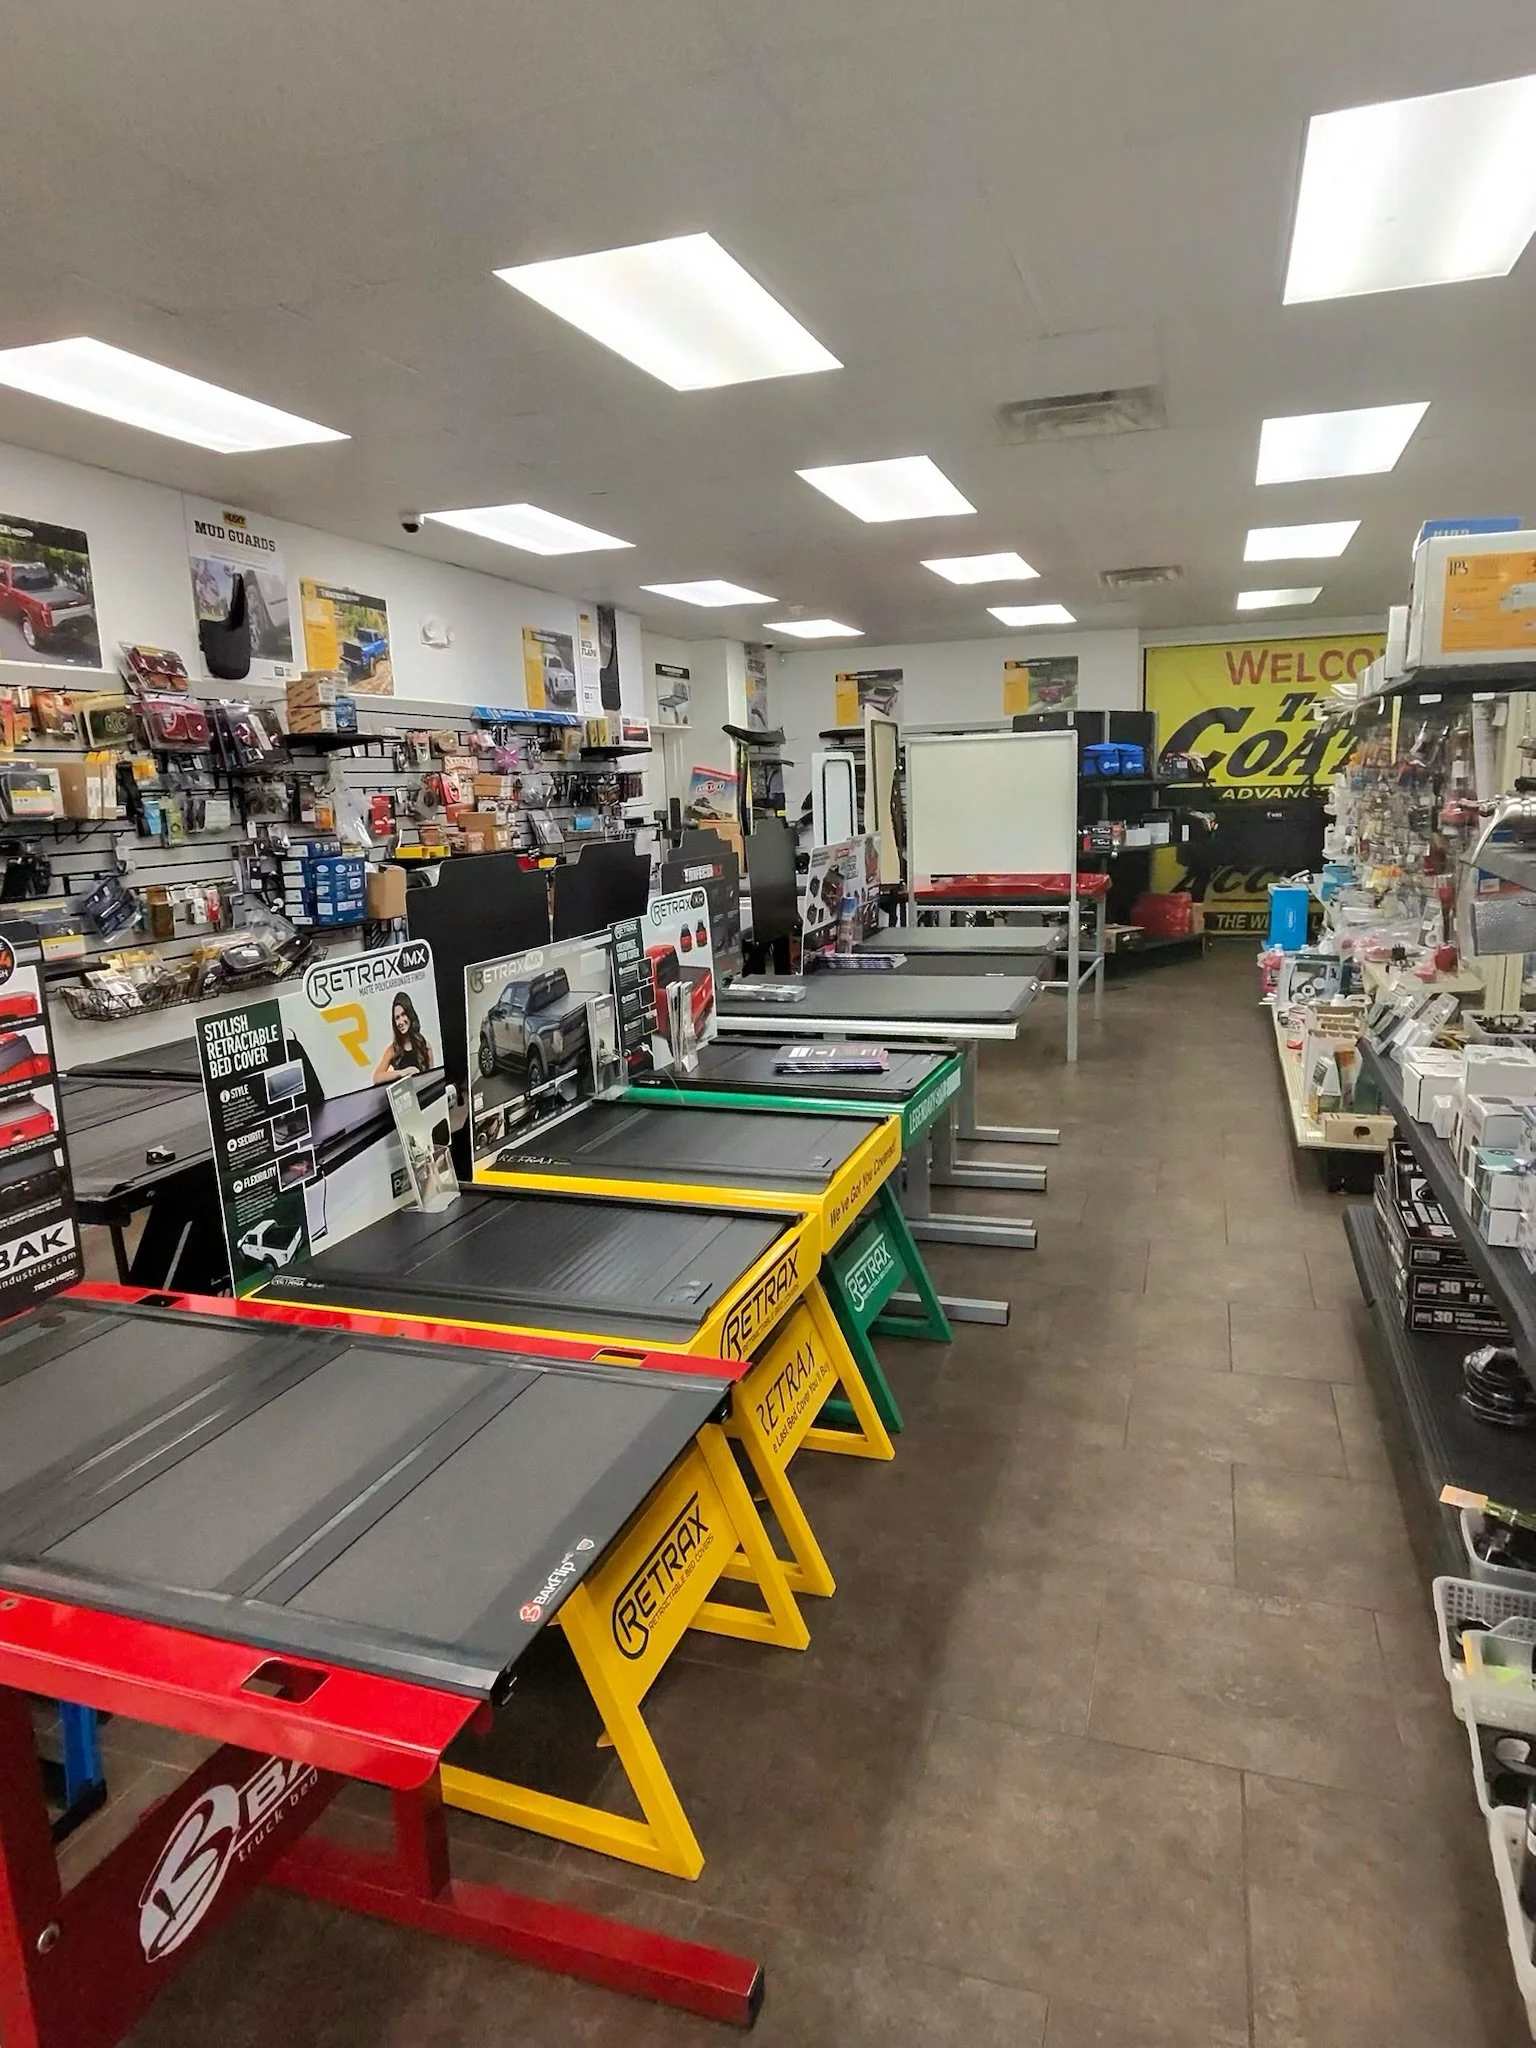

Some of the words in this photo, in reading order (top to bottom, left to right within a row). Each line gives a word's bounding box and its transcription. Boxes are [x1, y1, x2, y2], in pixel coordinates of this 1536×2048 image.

[194, 520, 225, 540] MUD
[228, 529, 276, 553] GUARDS
[1226, 648, 1376, 686] WELCO
[651, 894, 692, 926] RETRAX
[1217, 914, 1246, 929] THE
[307, 948, 401, 1008] RETRAX
[408, 948, 426, 967] MX
[470, 955, 525, 993] RETRAX
[204, 1014, 249, 1041] STYLISH
[206, 1024, 279, 1061] RETRACTABLE
[209, 1056, 232, 1079] BED
[233, 1046, 269, 1071] COVER
[230, 1084, 249, 1099] STYLE
[236, 1128, 265, 1148] SECURITY
[243, 1166, 277, 1189] FLEXIBILITY
[845, 1232, 891, 1312] RETRAX
[1440, 1280, 1461, 1294] 30
[720, 1235, 800, 1361] RETRAX
[1433, 1310, 1453, 1323] 30
[776, 1424, 790, 1447] Last
[786, 1410, 798, 1430] Bed
[796, 1390, 811, 1415] Cover
[532, 1562, 576, 1605] BAKFlip
[612, 1490, 709, 1660] RETRAX
[649, 1574, 686, 1632] RETRACTABLE
[684, 1561, 696, 1578] BED
[694, 1534, 714, 1564] COVERS
[238, 1809, 285, 1862] truck
[290, 1767, 318, 1807] bed
